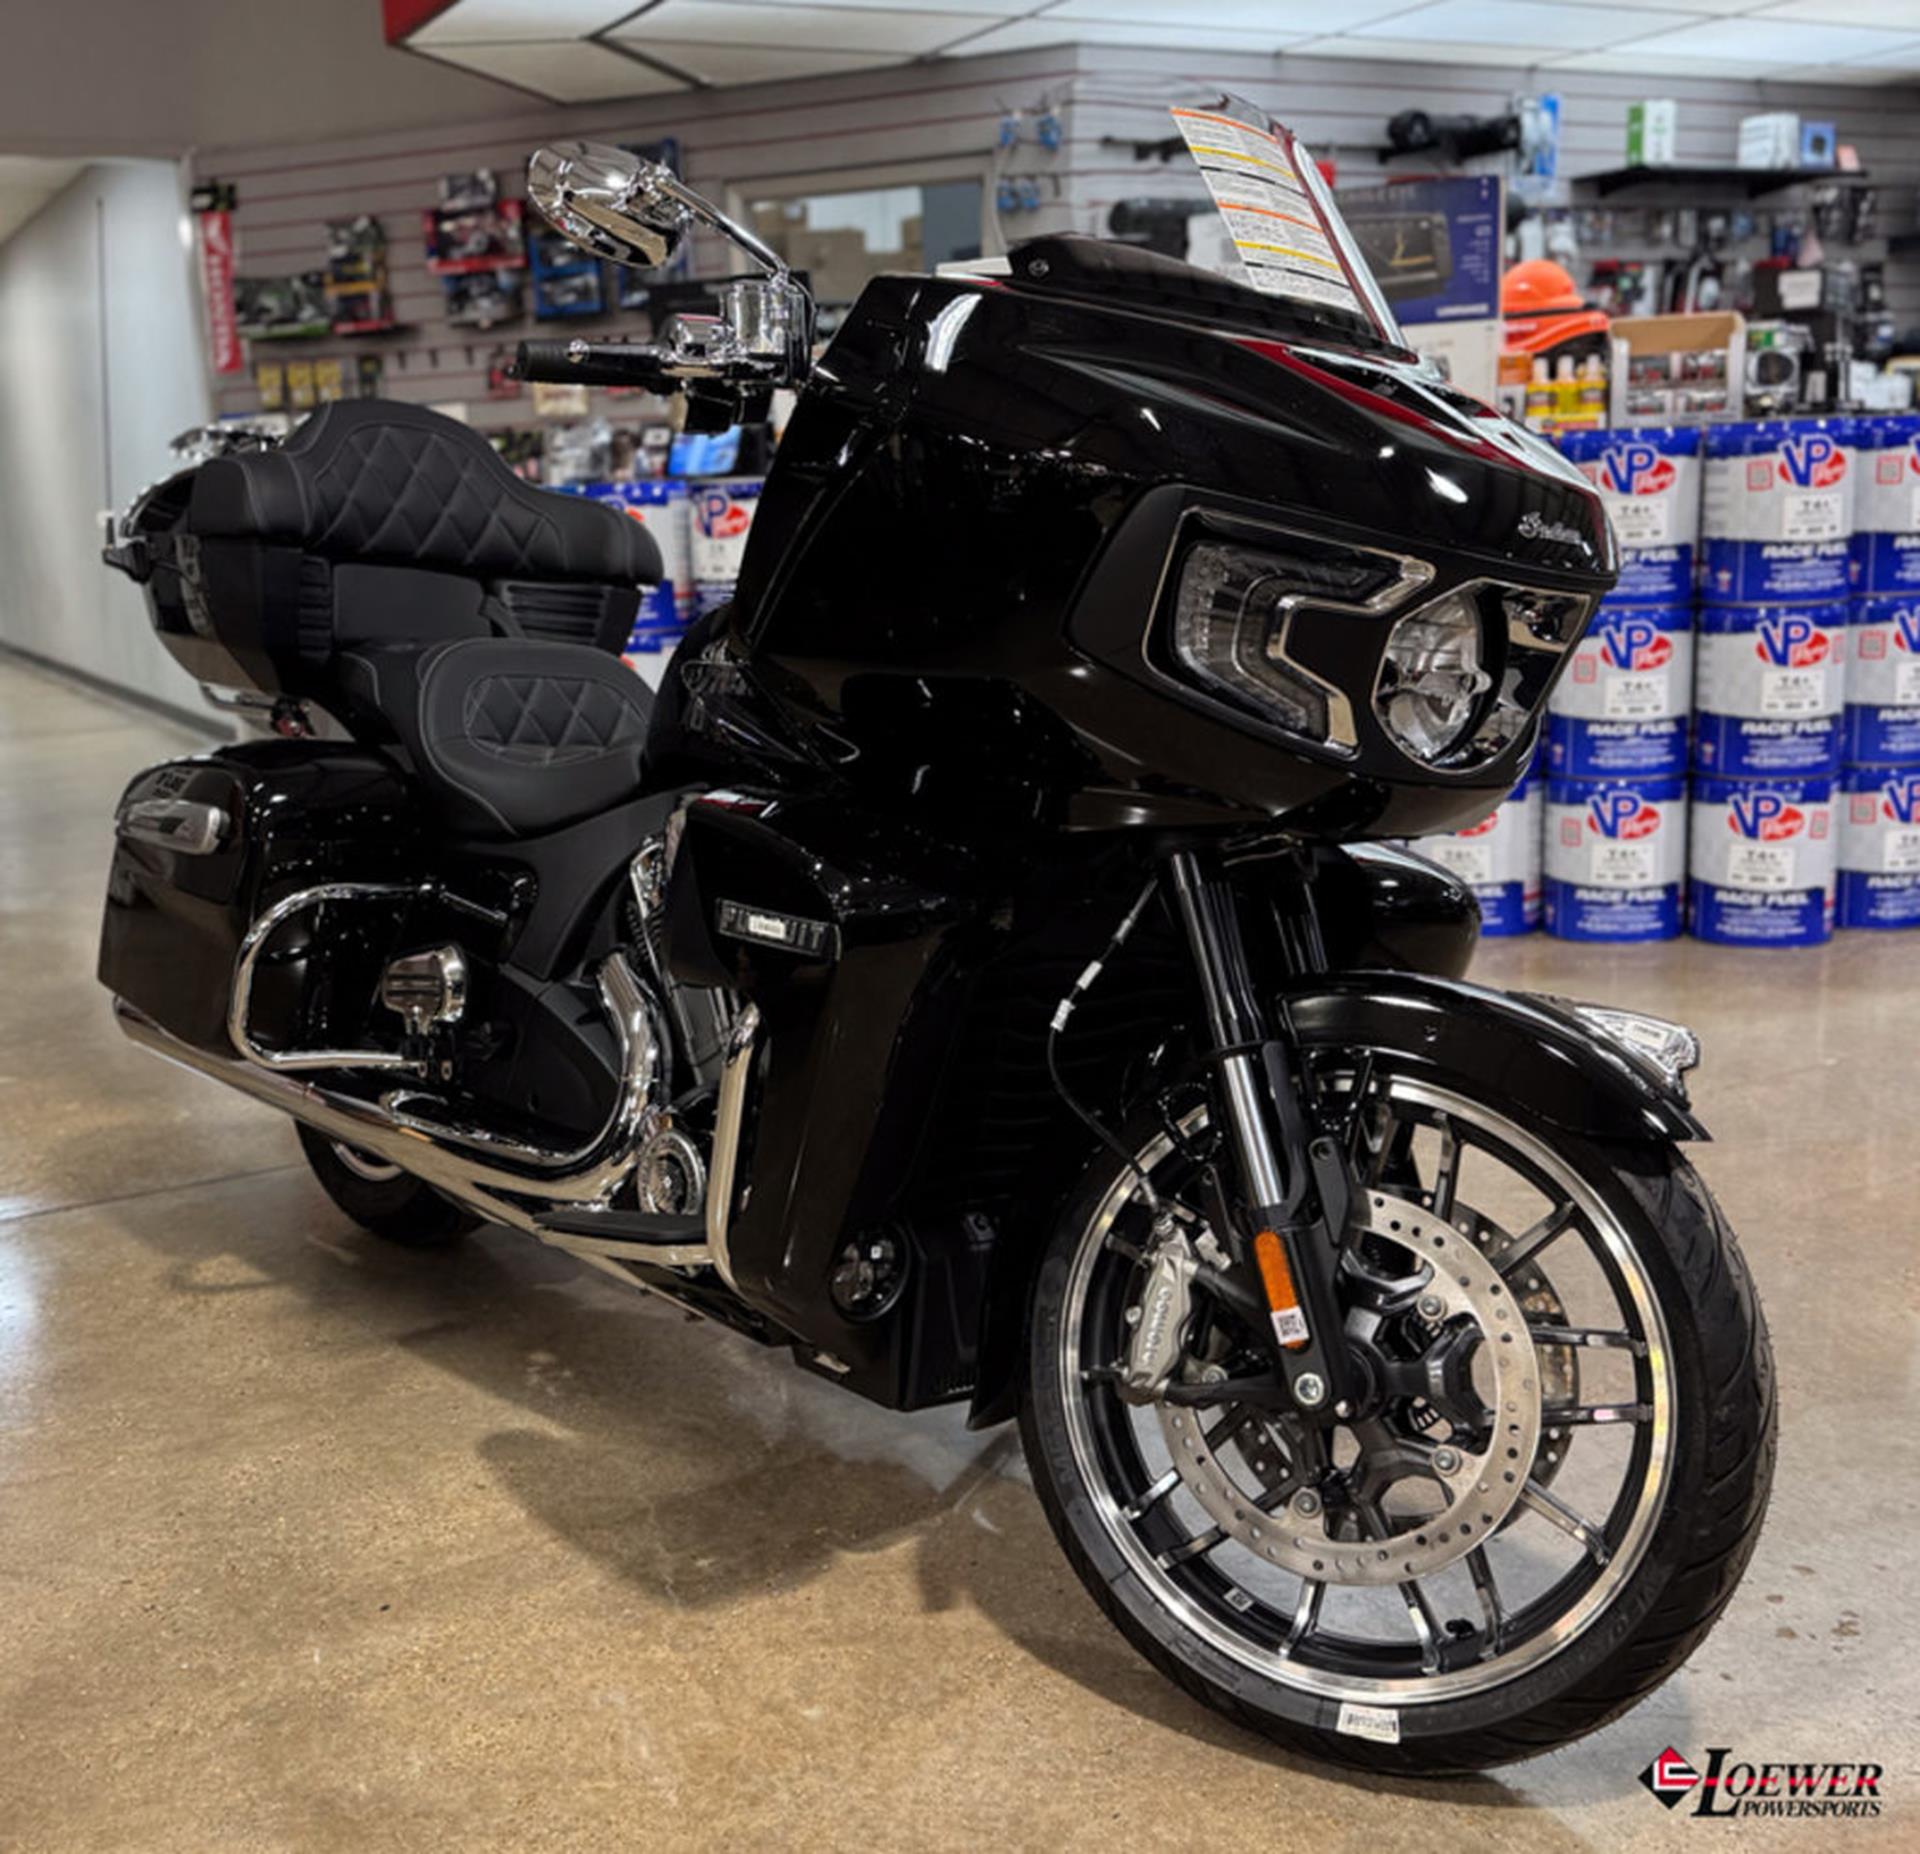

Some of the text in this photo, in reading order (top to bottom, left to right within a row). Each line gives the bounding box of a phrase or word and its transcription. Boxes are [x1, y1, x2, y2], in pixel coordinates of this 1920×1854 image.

[1602, 445, 1656, 494] VP
[1781, 436, 1832, 487] VP
[1603, 624, 1655, 670] VP
[1758, 619, 1812, 667] VP
[1591, 795, 1642, 839] VP
[1732, 795, 1783, 840] VP
